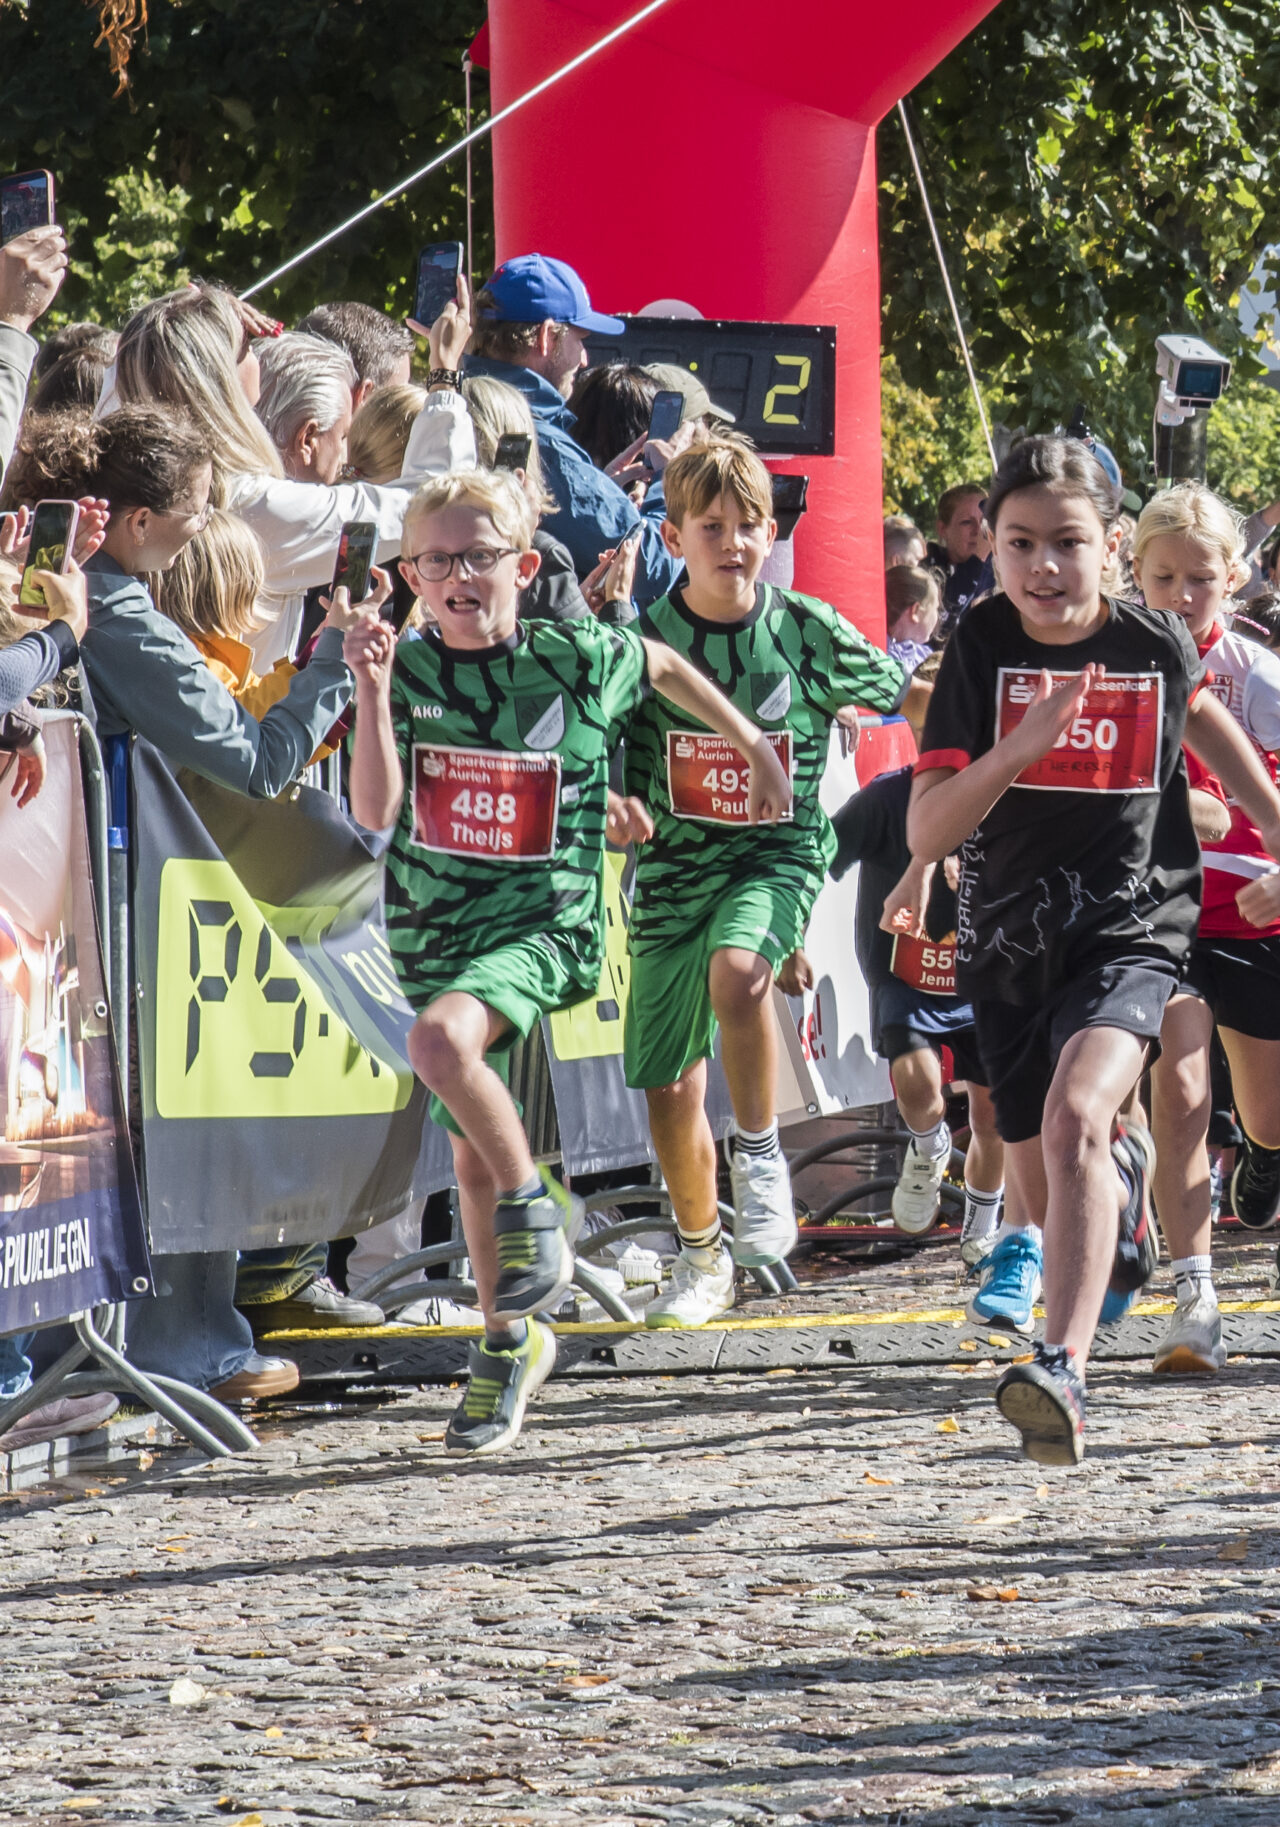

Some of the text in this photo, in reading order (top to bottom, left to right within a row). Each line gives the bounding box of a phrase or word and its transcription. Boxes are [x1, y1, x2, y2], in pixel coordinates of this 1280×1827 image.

[762, 354, 812, 424] 2
[411, 705, 443, 719] AKO
[449, 754, 550, 773] Sparkassenlauf
[697, 751, 734, 761] Aurich
[448, 767, 491, 784] Aurich
[451, 788, 517, 824] 488
[450, 821, 514, 852] Theijs
[921, 947, 956, 969] 55
